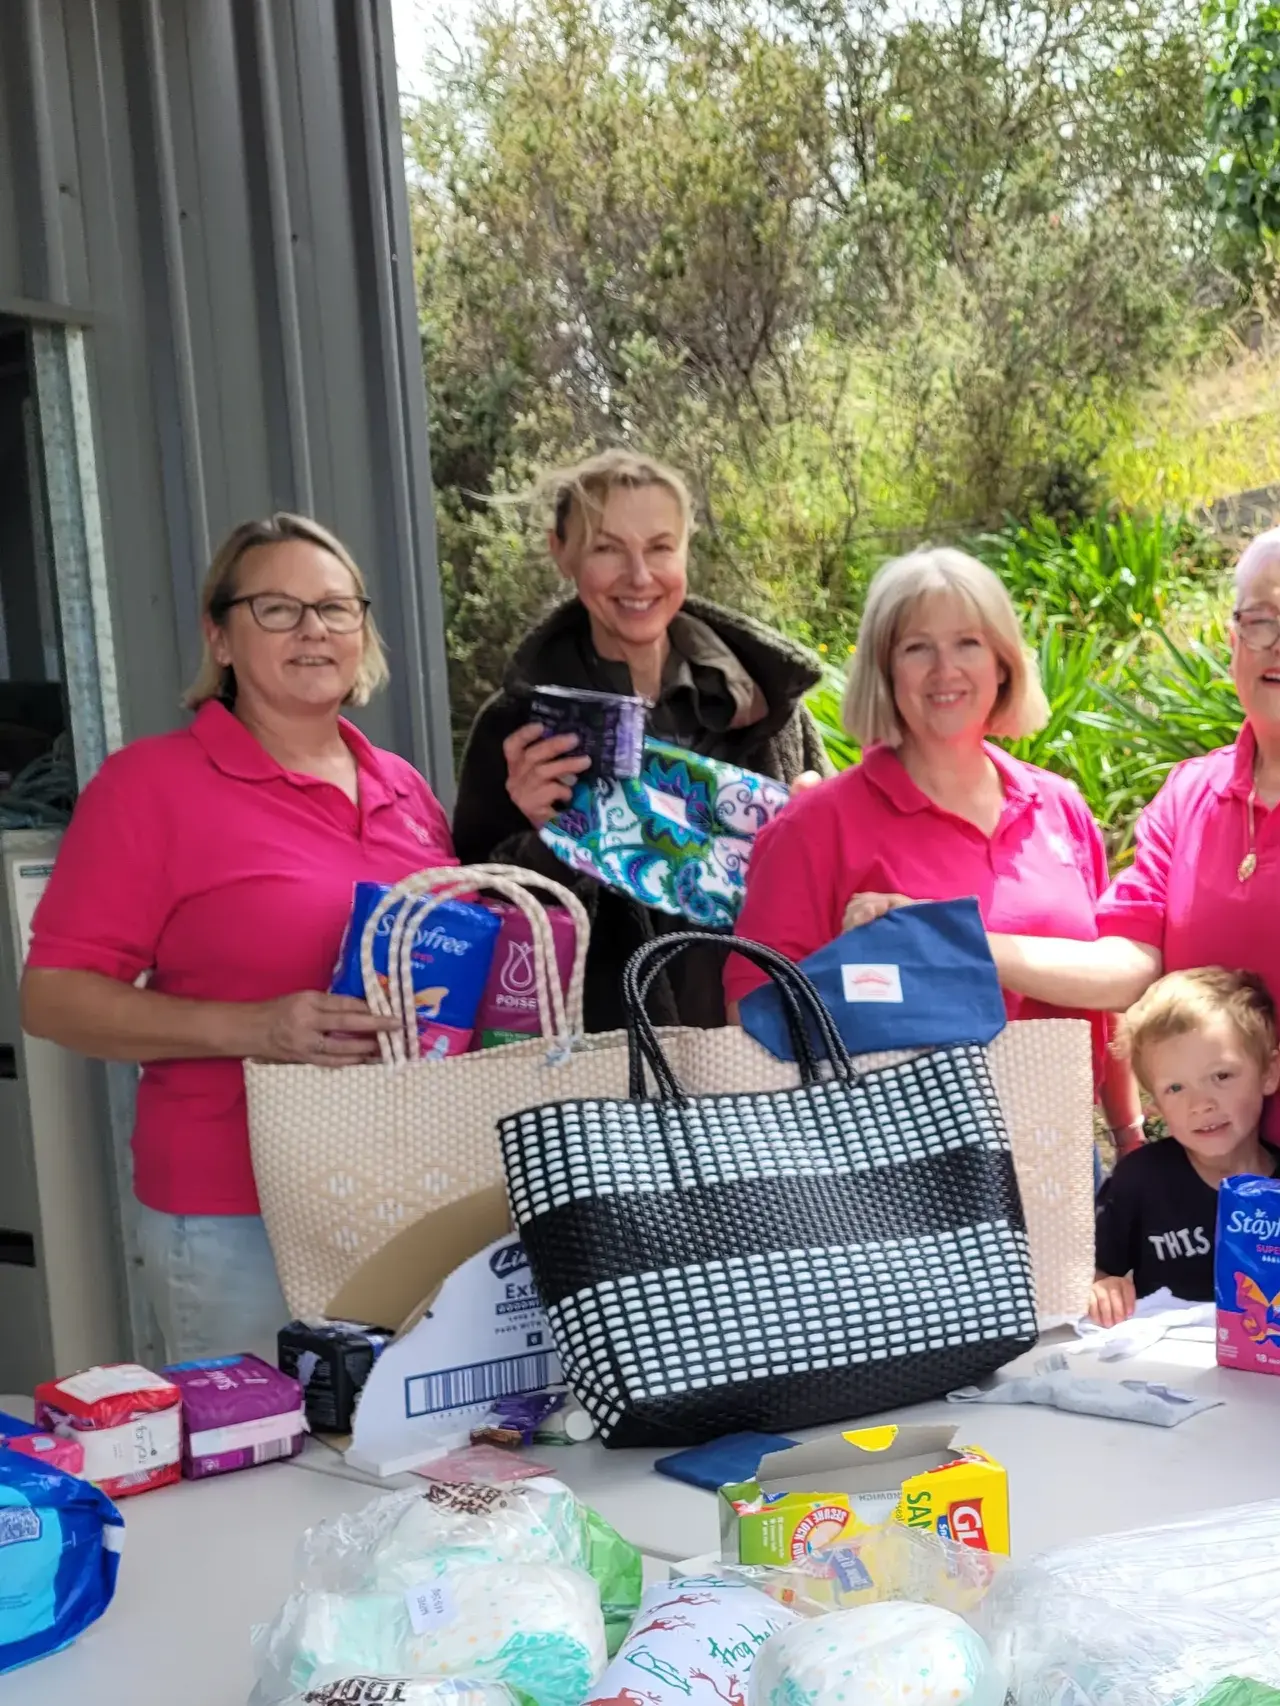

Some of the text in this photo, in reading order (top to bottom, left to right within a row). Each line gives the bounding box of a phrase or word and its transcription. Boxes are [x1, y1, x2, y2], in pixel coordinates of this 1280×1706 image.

[375, 914, 473, 956] Syfree
[496, 993, 537, 1010] POISE
[1148, 1226, 1211, 1261] THIS
